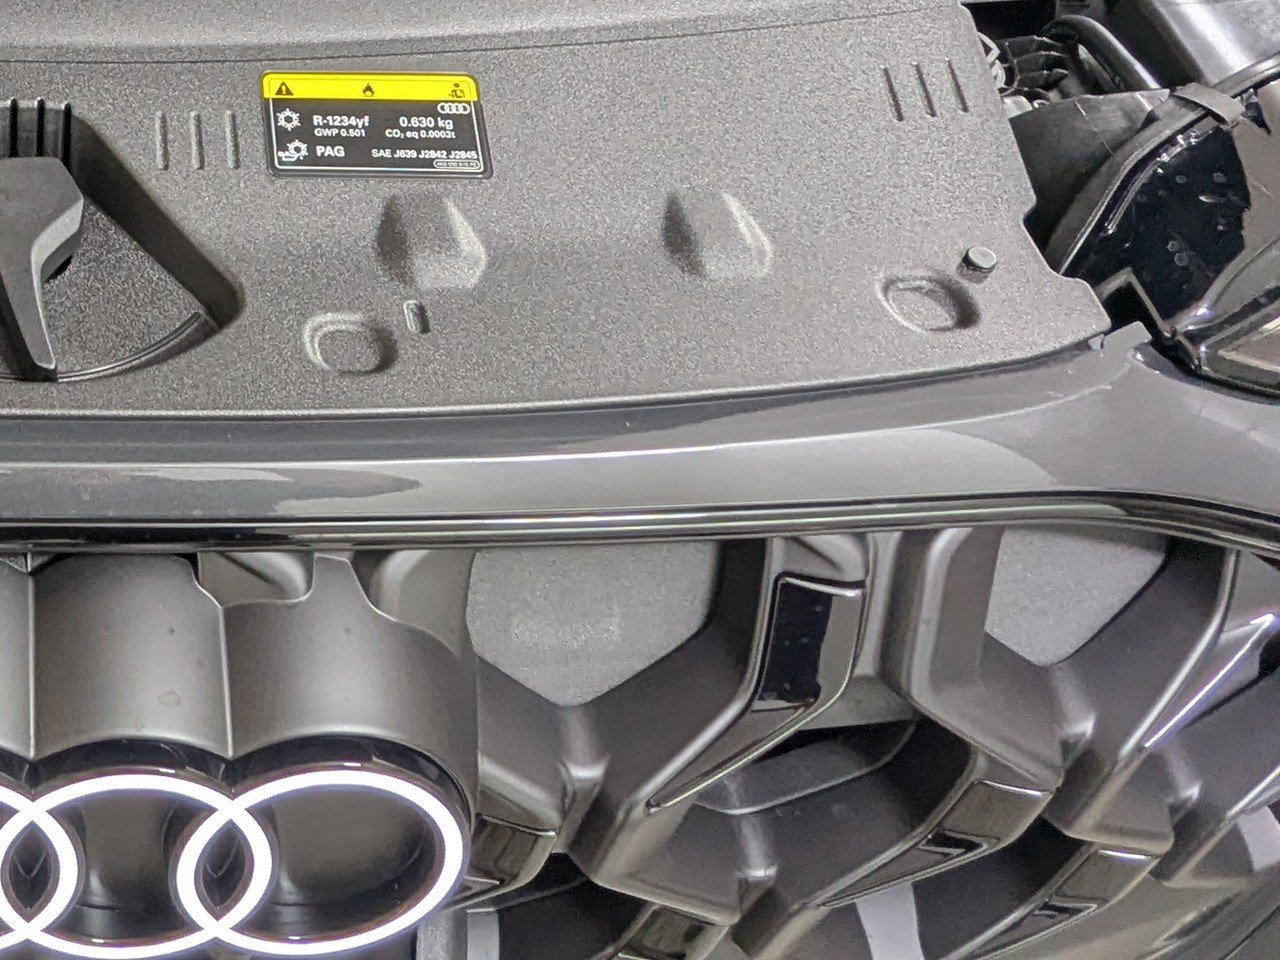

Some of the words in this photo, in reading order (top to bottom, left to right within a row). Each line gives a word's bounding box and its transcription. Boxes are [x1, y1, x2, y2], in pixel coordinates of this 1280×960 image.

[313, 115, 370, 128] R-1234yf
[399, 117, 435, 128] 0.630
[437, 117, 454, 130] kg
[314, 128, 339, 137] GWP
[340, 129, 366, 137] 0.501
[406, 131, 419, 140] eq
[420, 130, 456, 139] 0.0003t
[316, 146, 345, 157] PAG
[372, 149, 392, 158] SAE
[394, 149, 417, 158] J639
[419, 150, 447, 159] J2842
[449, 150, 478, 160] J2845
